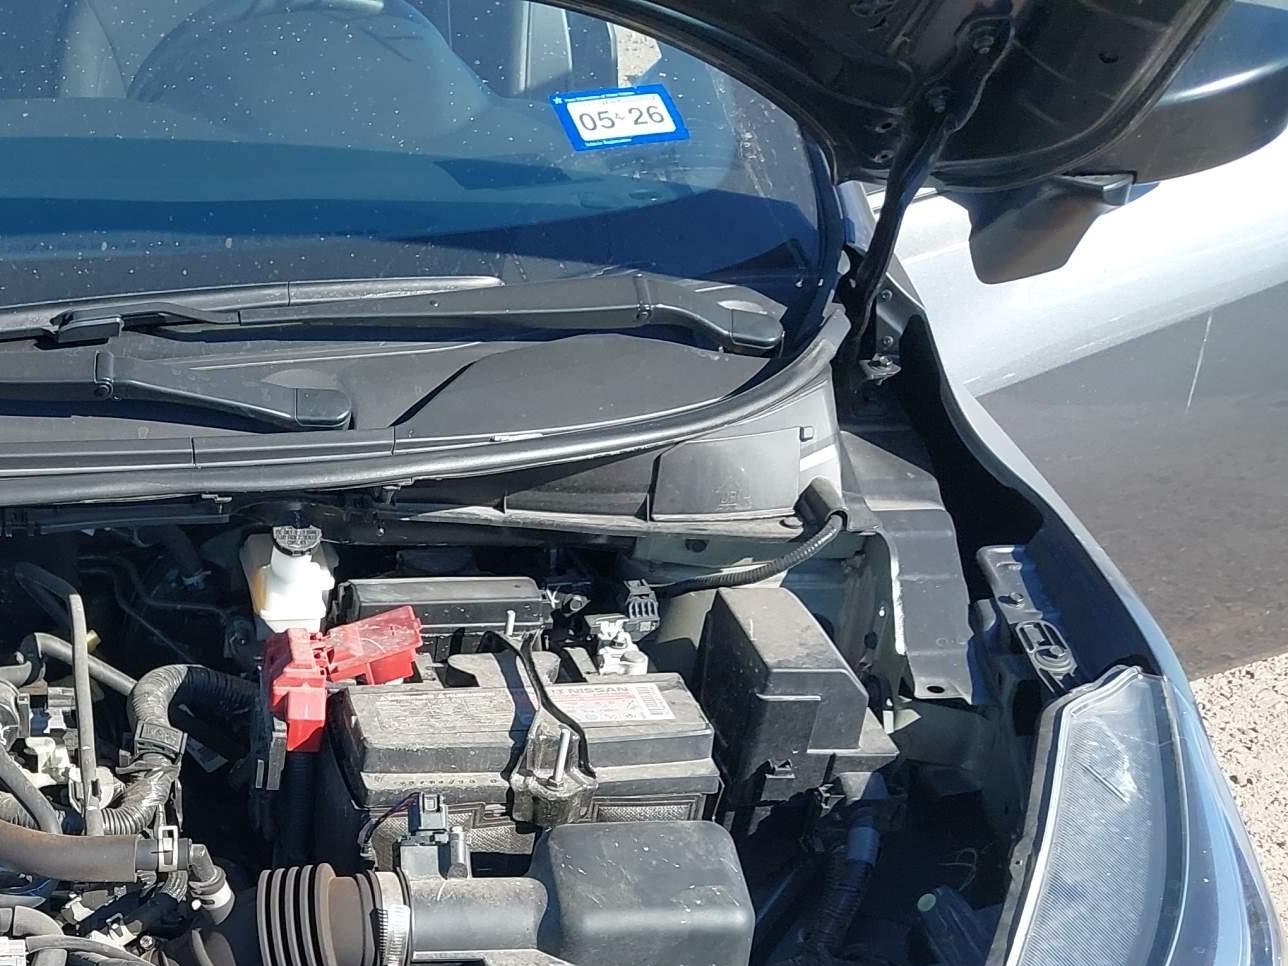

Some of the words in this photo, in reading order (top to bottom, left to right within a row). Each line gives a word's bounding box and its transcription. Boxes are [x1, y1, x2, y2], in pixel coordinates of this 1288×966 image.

[578, 110, 616, 132] 05
[628, 105, 665, 126] 26
[568, 686, 629, 695] NISSAN
